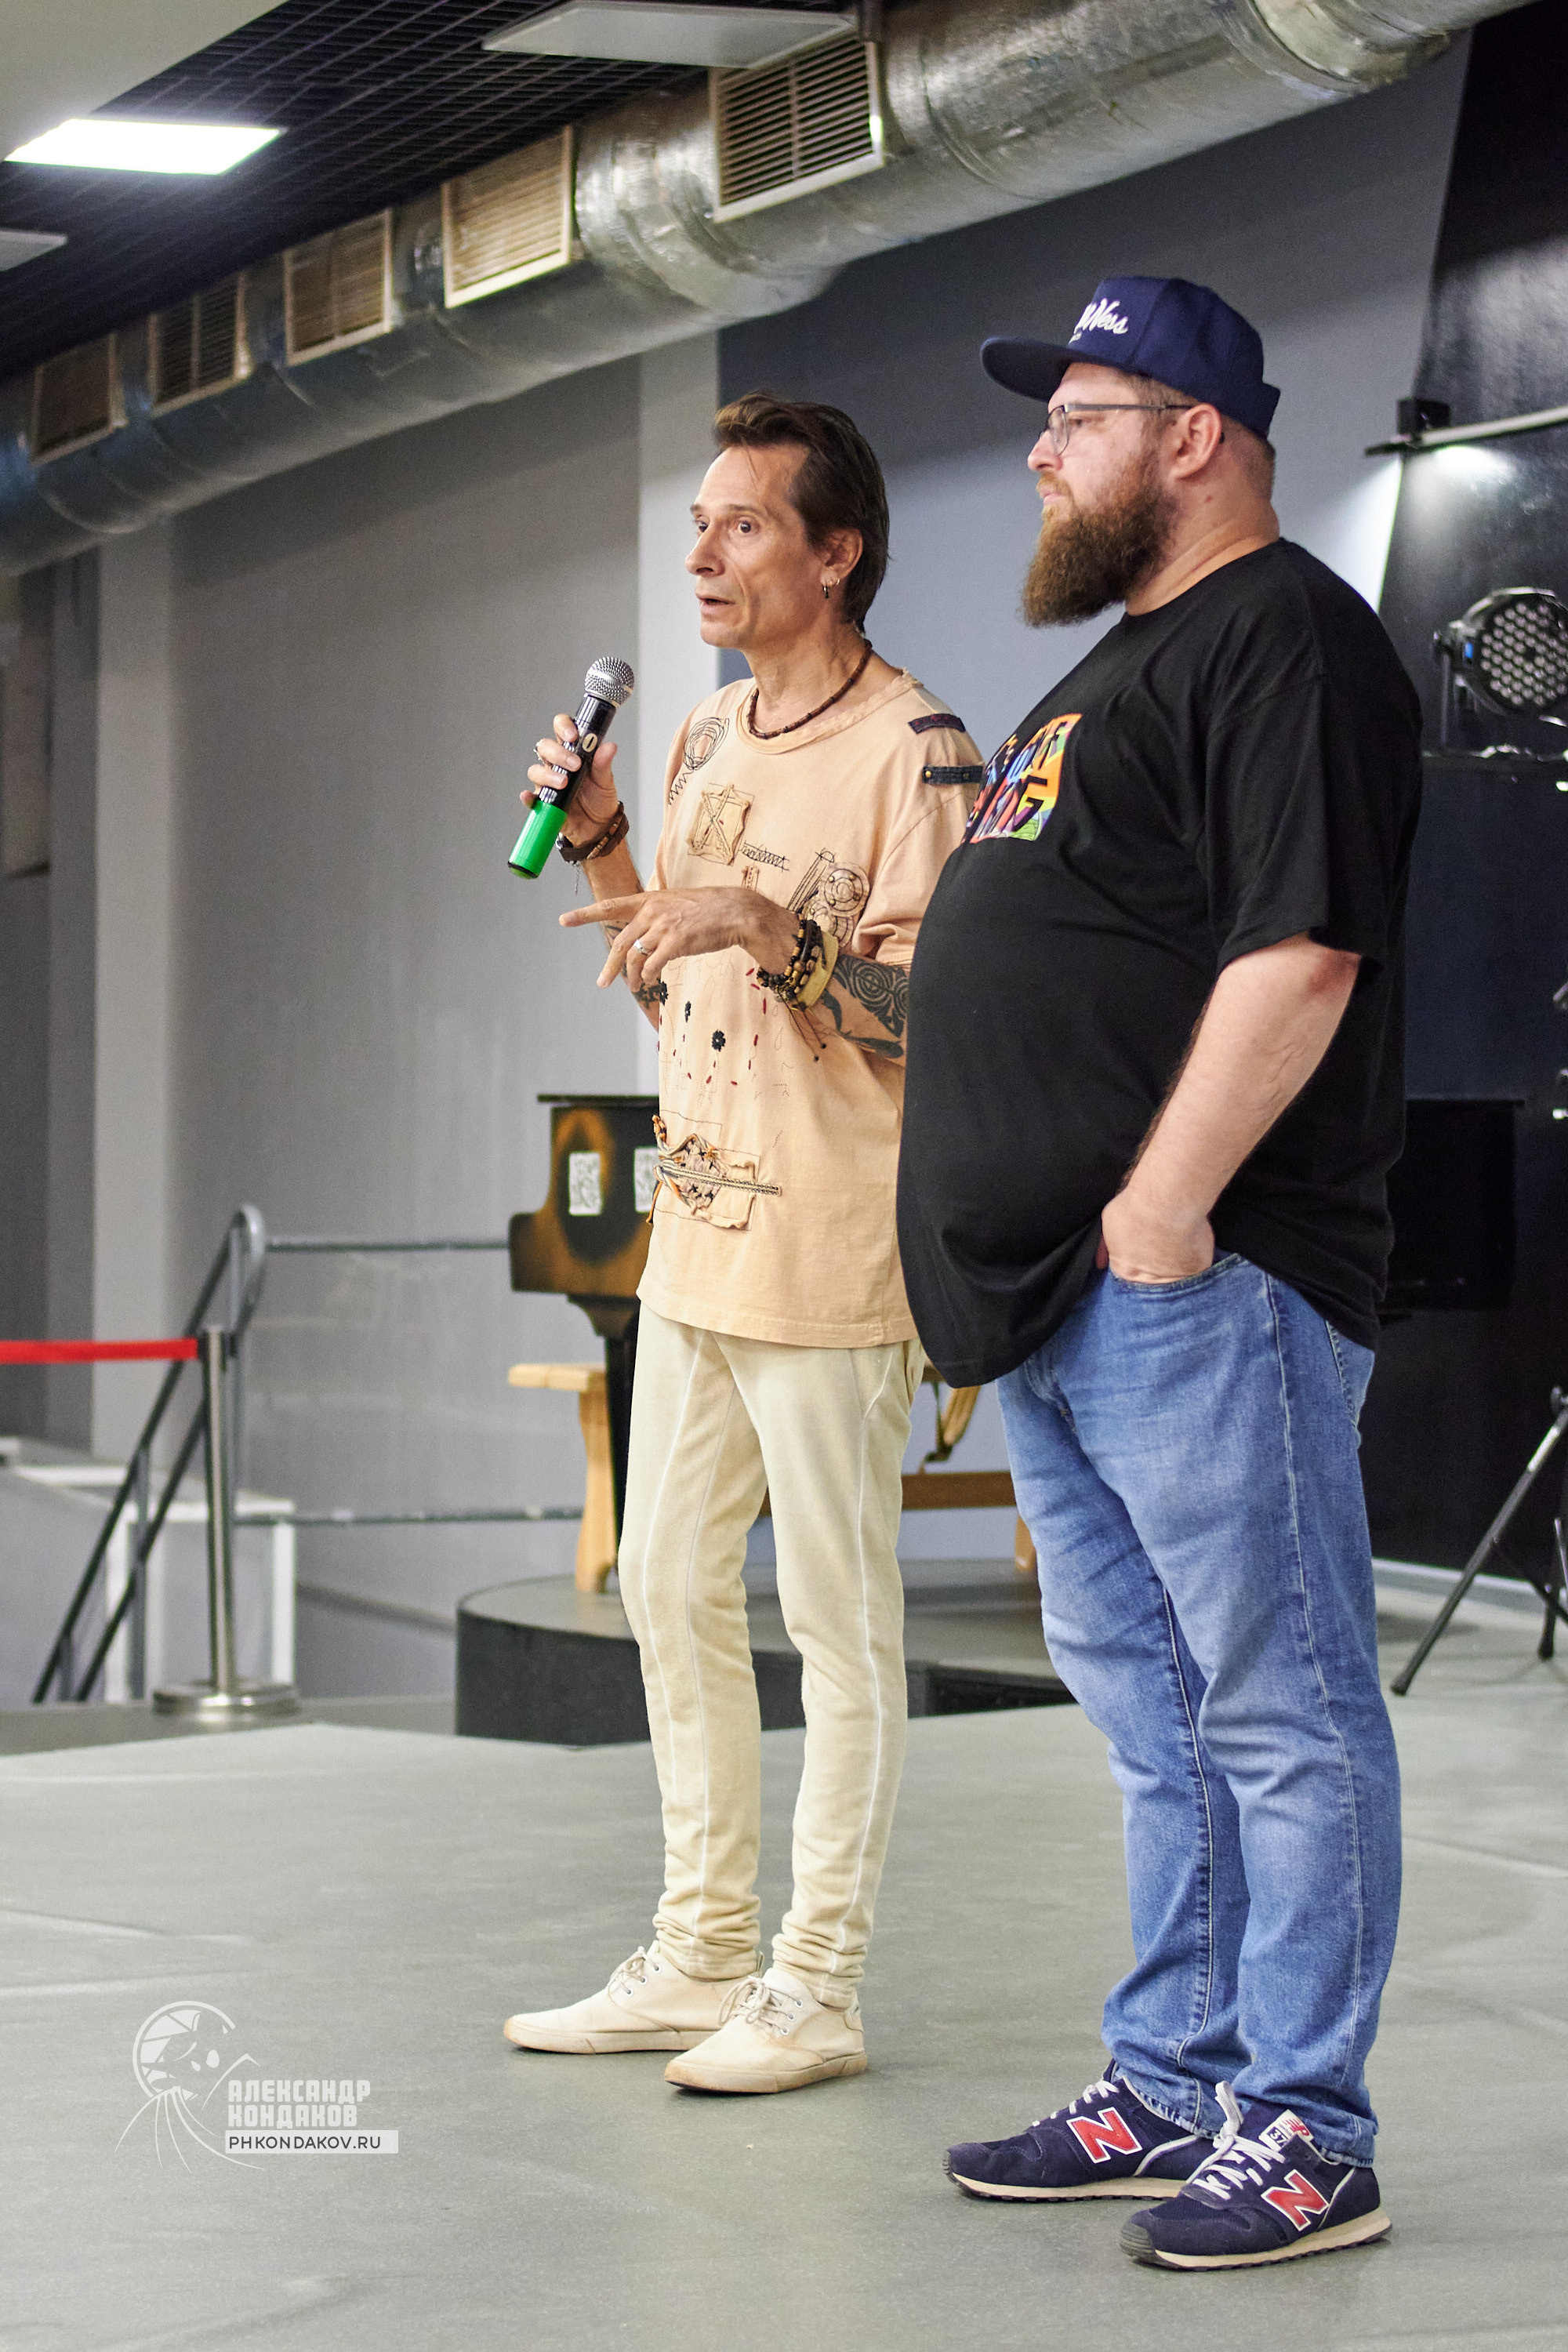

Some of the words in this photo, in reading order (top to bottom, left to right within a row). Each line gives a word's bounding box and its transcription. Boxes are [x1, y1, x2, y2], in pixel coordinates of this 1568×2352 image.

[1067, 2107, 1142, 2164] N
[1269, 2129, 1287, 2145] 37
[1261, 2169, 1329, 2231] N
